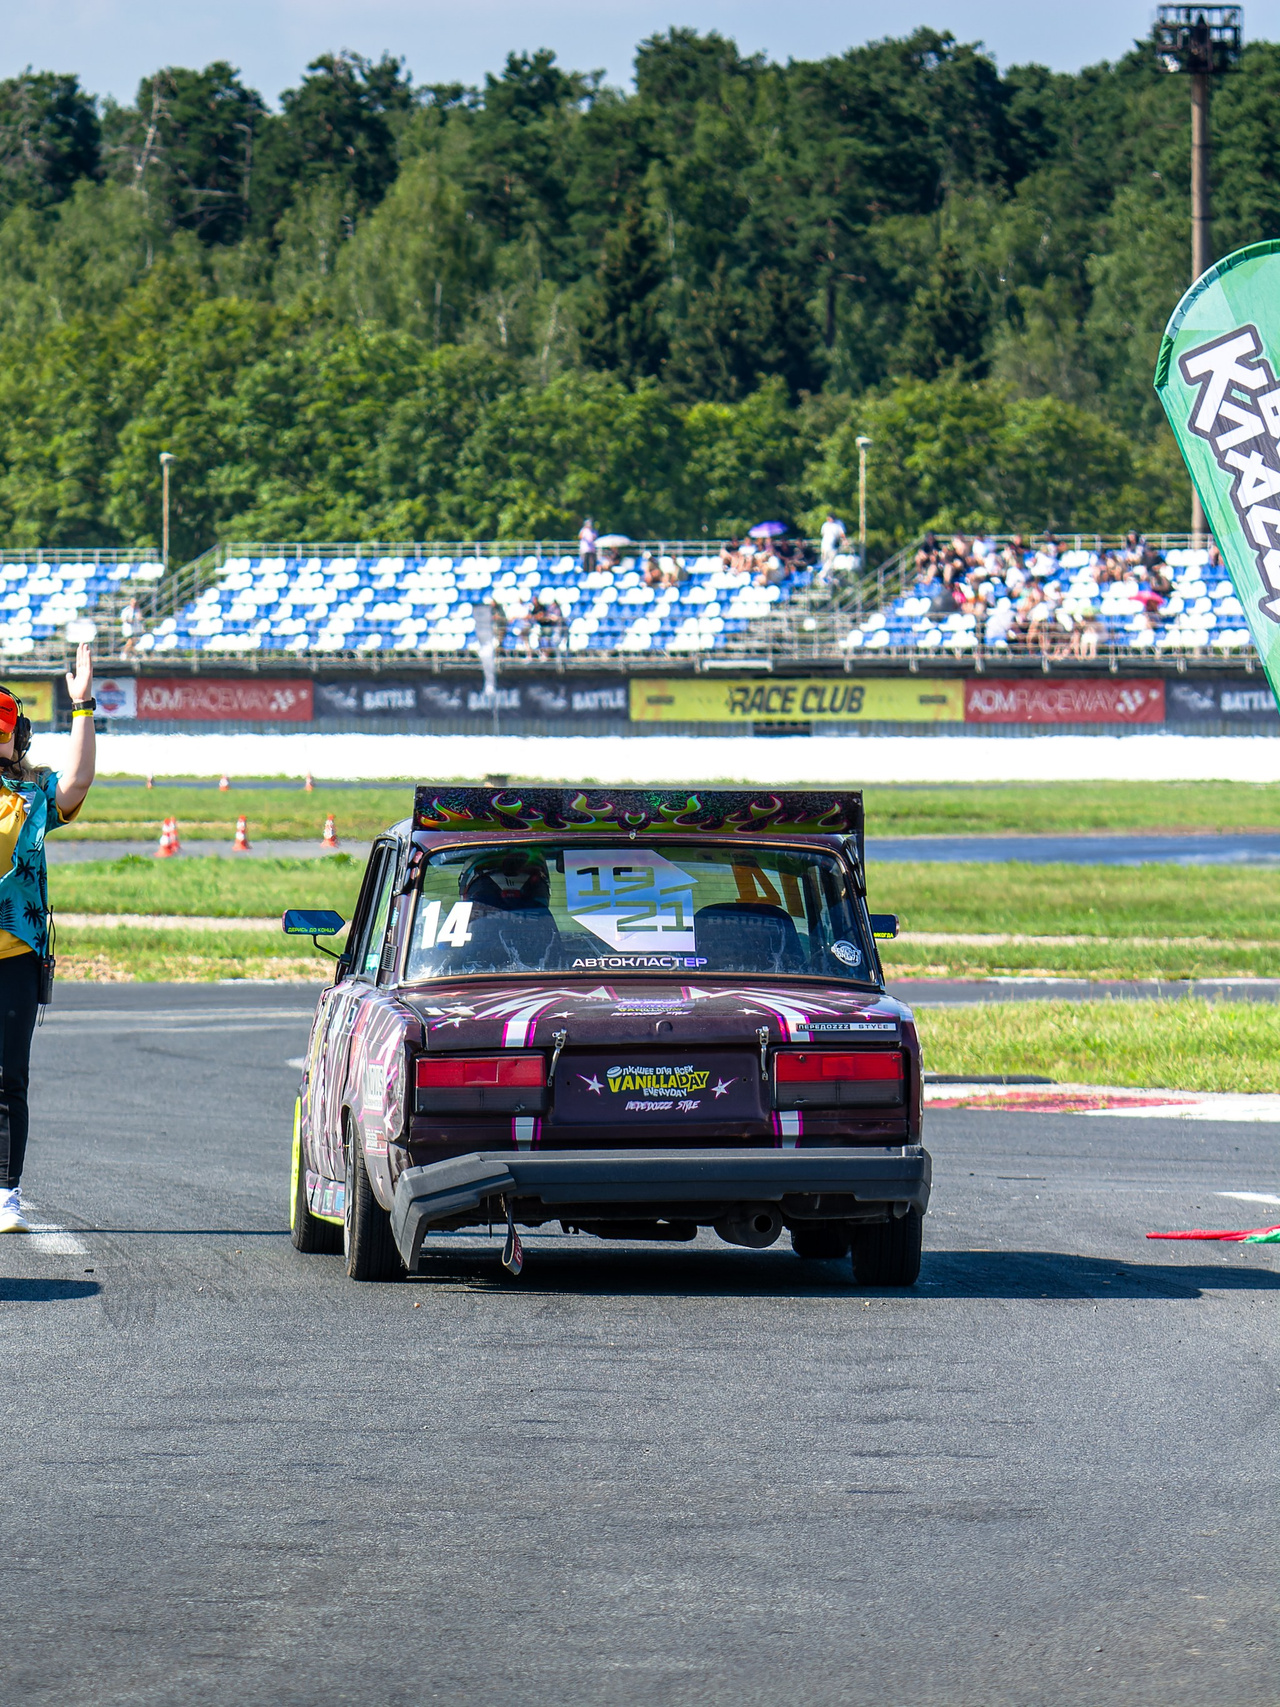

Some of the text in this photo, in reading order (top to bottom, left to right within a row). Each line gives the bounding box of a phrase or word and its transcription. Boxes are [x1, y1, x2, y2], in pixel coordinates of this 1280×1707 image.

[362, 688, 417, 711] BATTLE
[571, 688, 627, 711] BATTLE
[727, 685, 866, 714] RACE CLUB
[420, 900, 474, 950] 14
[706, 915, 780, 928] BRIDE
[571, 956, 708, 969] АВТОКЛАСТЕР
[858, 1022, 889, 1030] STYLE
[643, 1087, 687, 1098] EVERYDAY
[675, 1099, 701, 1113] STYLE
